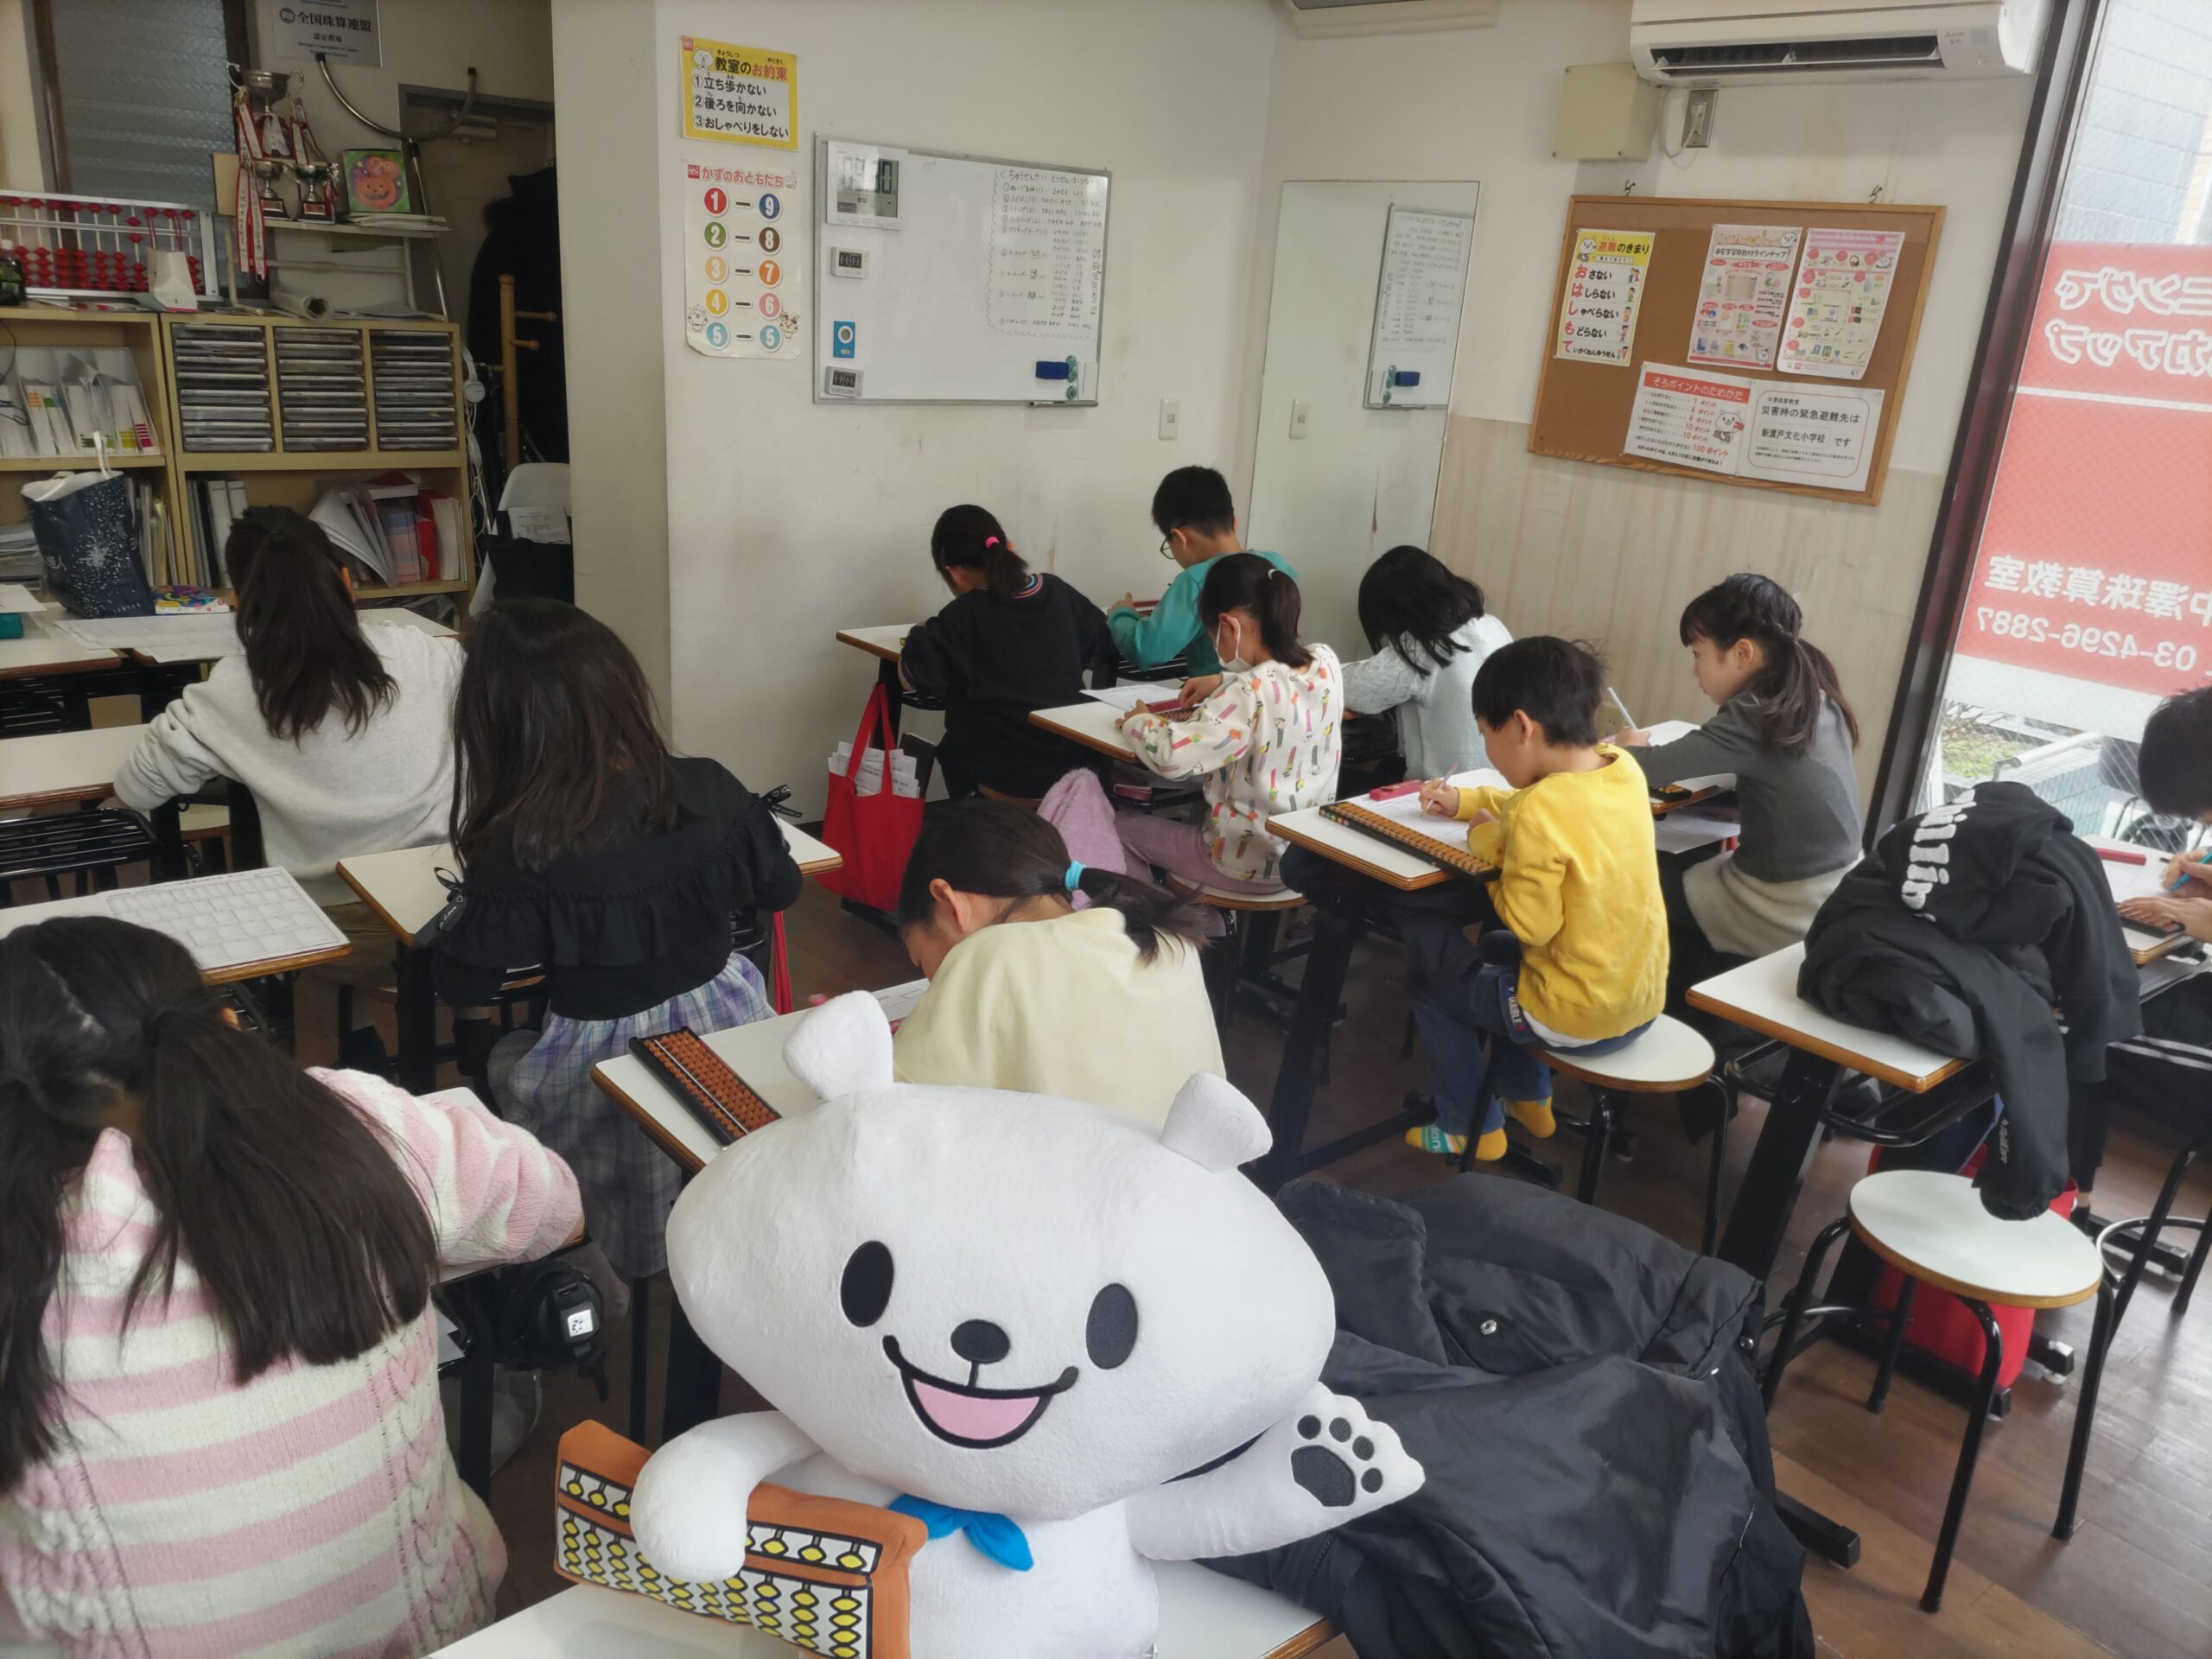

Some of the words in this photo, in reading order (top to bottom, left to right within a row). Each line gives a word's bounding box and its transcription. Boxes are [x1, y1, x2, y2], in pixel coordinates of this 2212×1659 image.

[297, 11, 372, 32] 全国珠算連盟
[715, 57, 787, 81] 教室のお約束
[702, 167, 784, 188] かずのおともだち
[711, 191, 720, 211] 1
[765, 197, 774, 216] 9
[710, 226, 720, 245] 2
[765, 230, 774, 250] 8
[1598, 241, 1650, 255] 避難のきまり
[711, 259, 721, 278] 3
[765, 264, 774, 283] 7
[711, 293, 721, 312] 4
[765, 296, 773, 315] 6
[713, 326, 722, 346] 5
[766, 328, 775, 346] 5
[1761, 406, 1860, 423] 災害時の緊急避難先は
[1762, 428, 1826, 443] 新渡戸文化小学校
[1834, 437, 1852, 448] です
